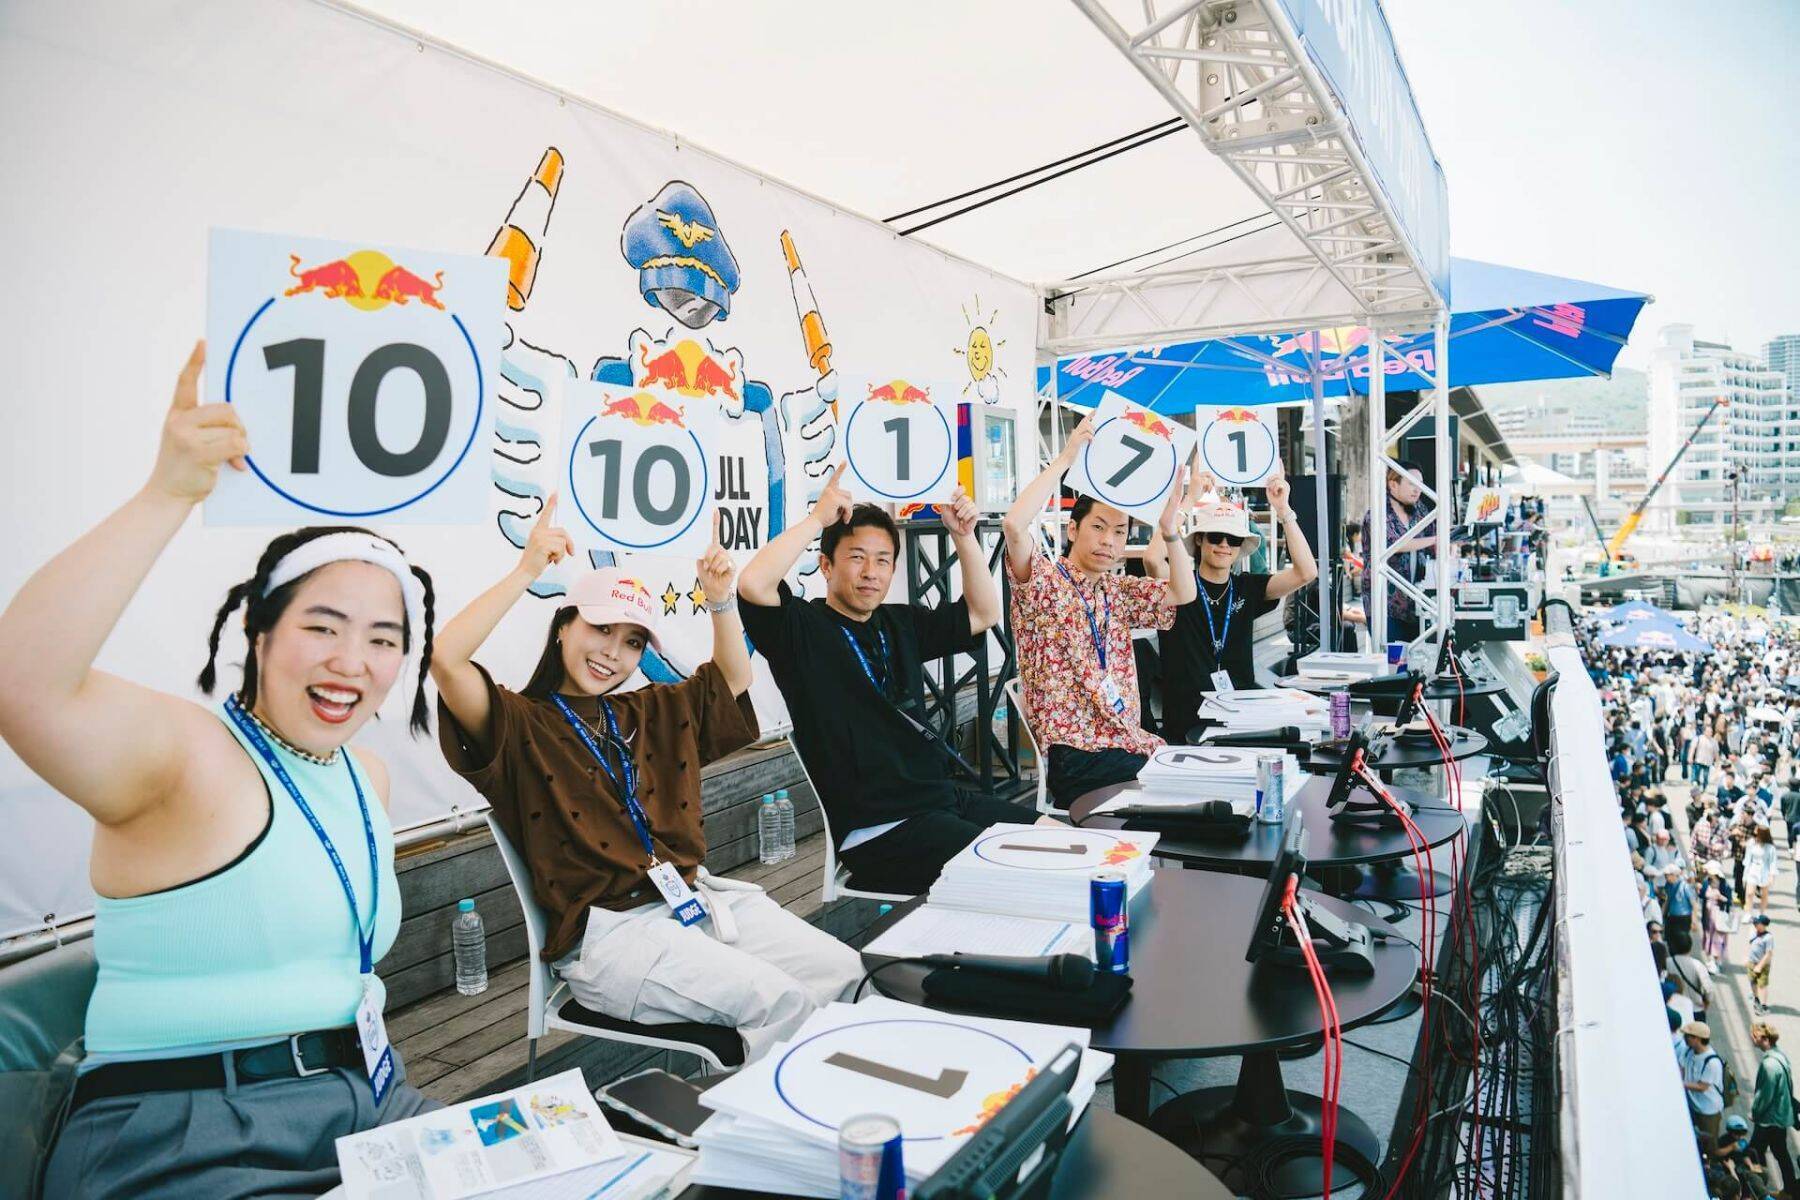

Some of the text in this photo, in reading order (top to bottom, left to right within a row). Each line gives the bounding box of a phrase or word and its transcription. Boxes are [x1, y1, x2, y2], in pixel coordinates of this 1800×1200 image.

[262, 338, 453, 478] 10
[884, 417, 910, 481] 1
[1105, 434, 1155, 488] 7
[1227, 431, 1247, 473] 1
[589, 438, 691, 526] 10
[718, 507, 762, 551] DAY
[612, 589, 653, 615] Red Bull
[1171, 753, 1242, 764] 2
[999, 844, 1088, 855] 1
[678, 901, 704, 923] JUDGE
[822, 1051, 969, 1099] 1
